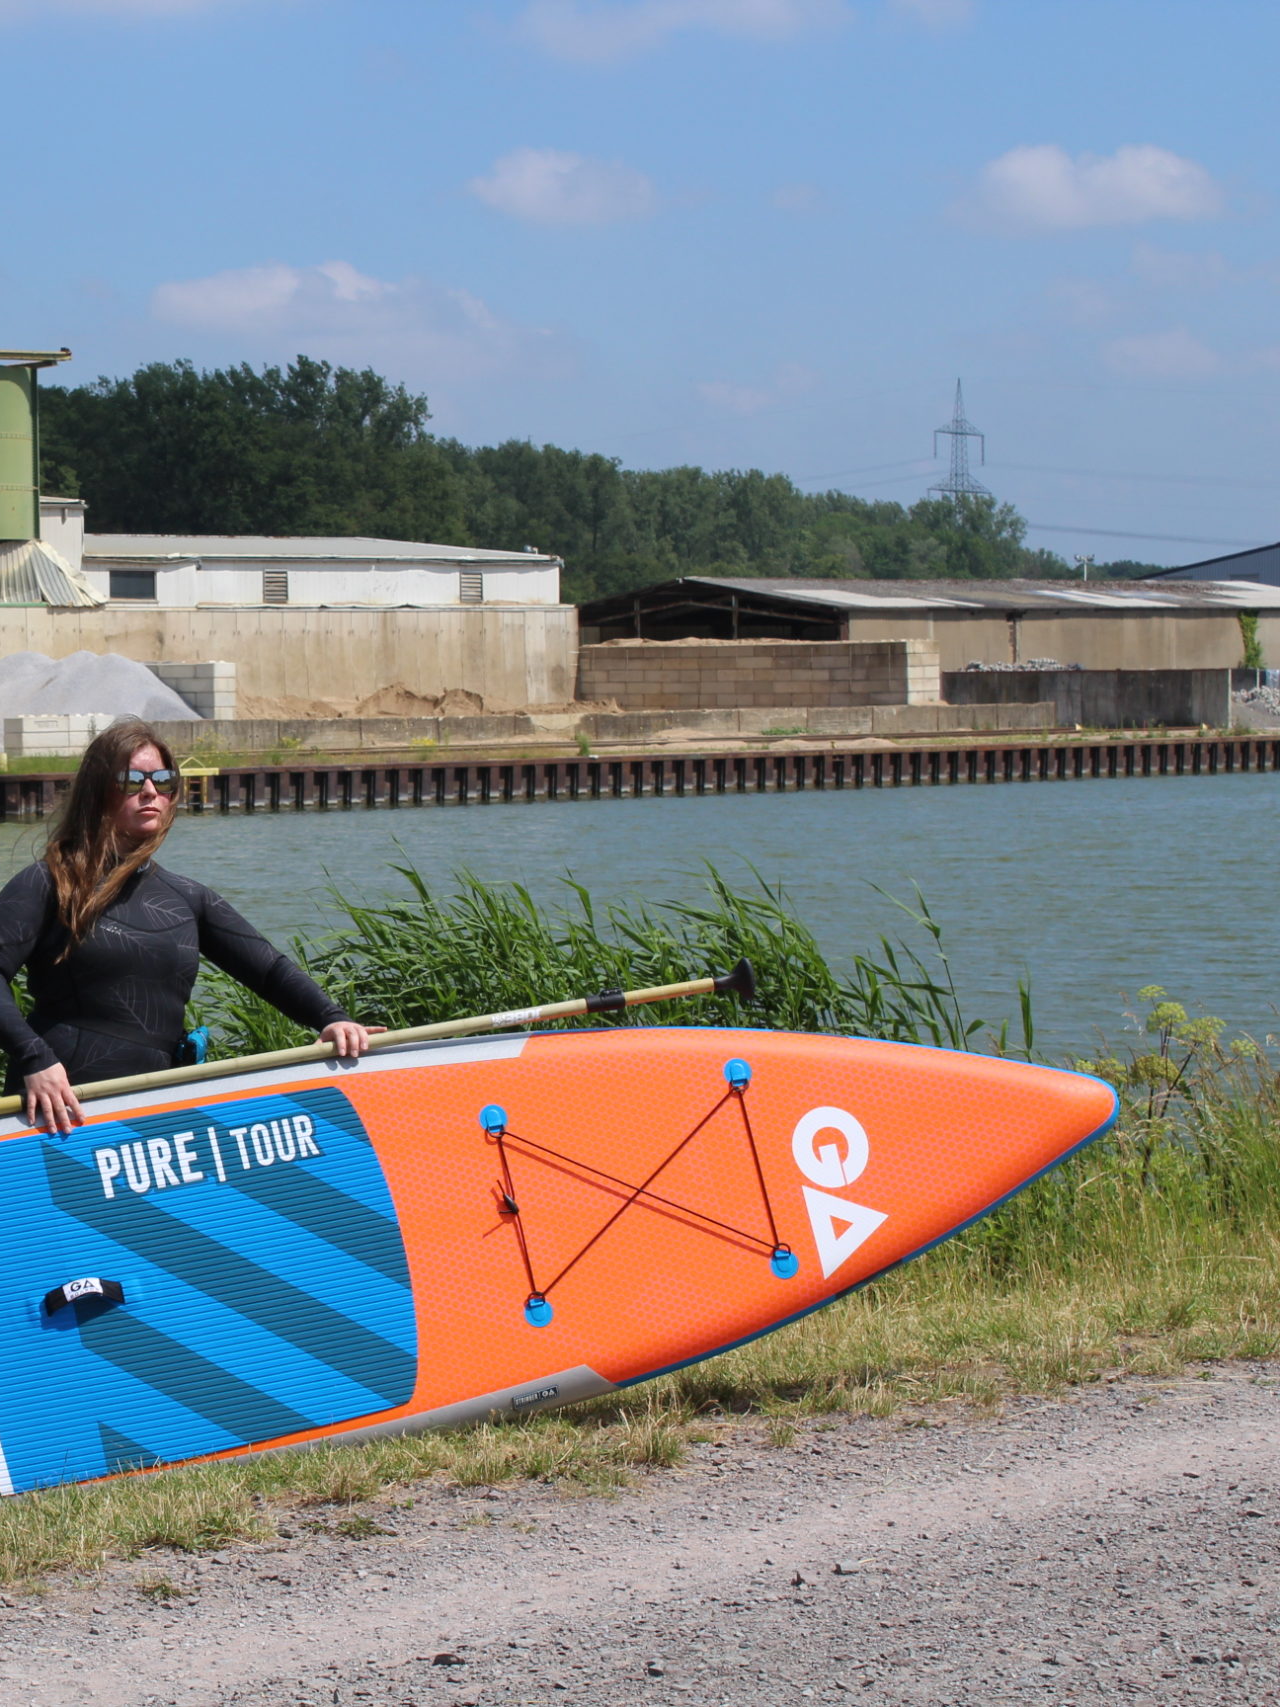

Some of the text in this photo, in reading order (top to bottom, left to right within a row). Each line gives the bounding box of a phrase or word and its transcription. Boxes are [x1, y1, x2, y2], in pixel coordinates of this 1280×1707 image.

[95, 1114, 320, 1200] PURE TOUR
[70, 1279, 95, 1292] GA
